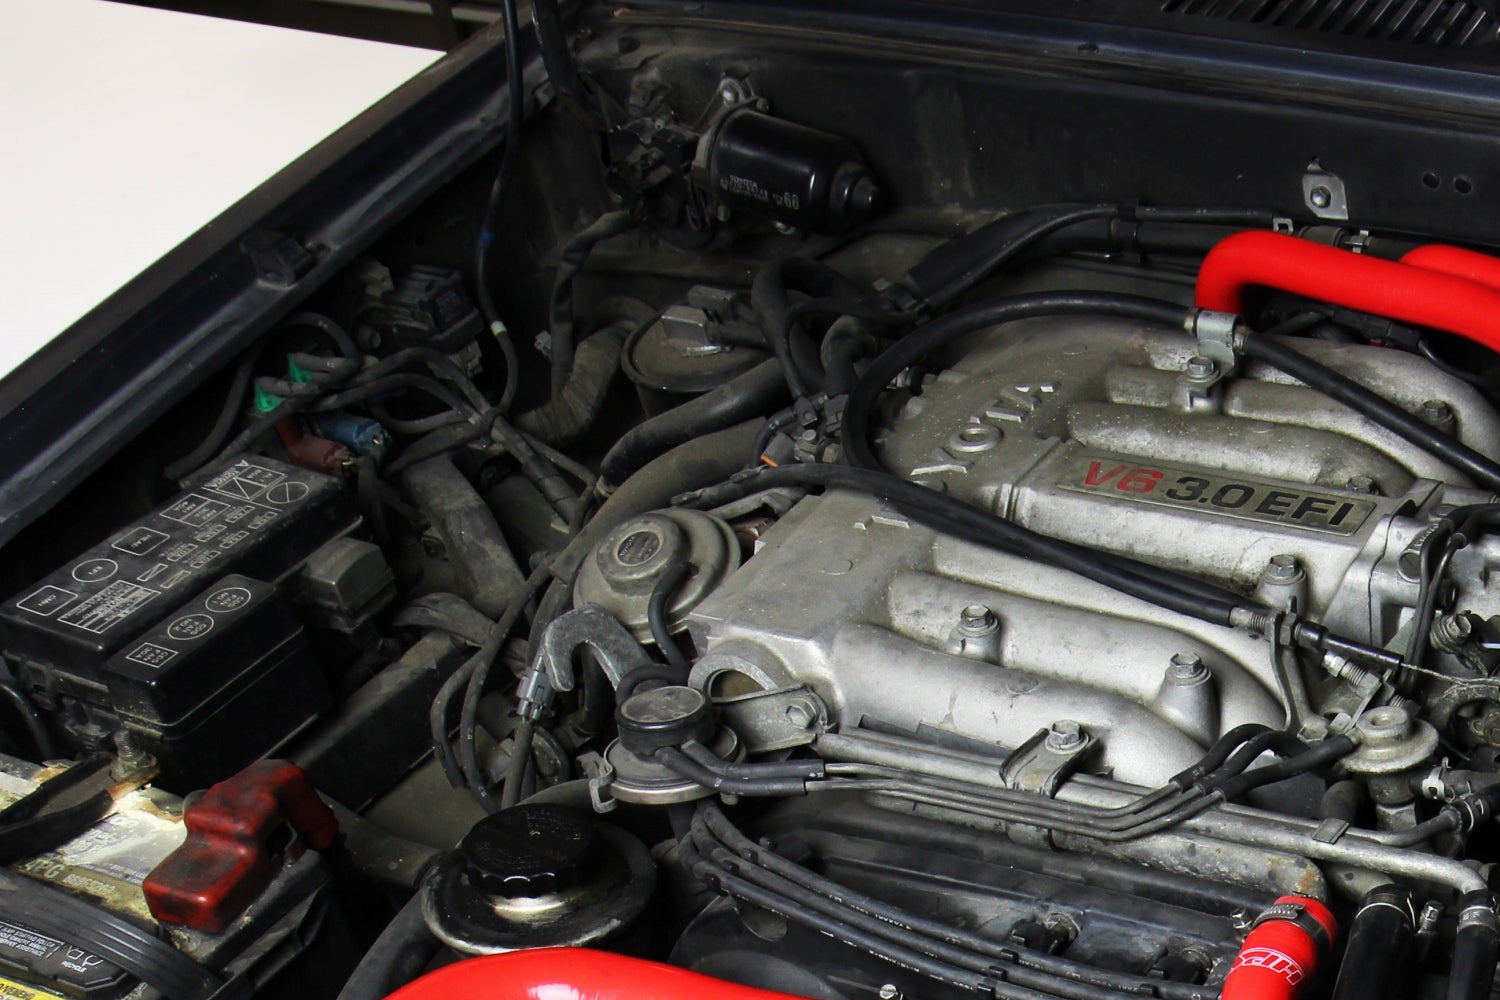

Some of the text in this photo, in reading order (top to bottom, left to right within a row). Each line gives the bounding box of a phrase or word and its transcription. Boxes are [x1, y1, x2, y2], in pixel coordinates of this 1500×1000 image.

[1084, 461, 1356, 525] V6 3.0 EFI
